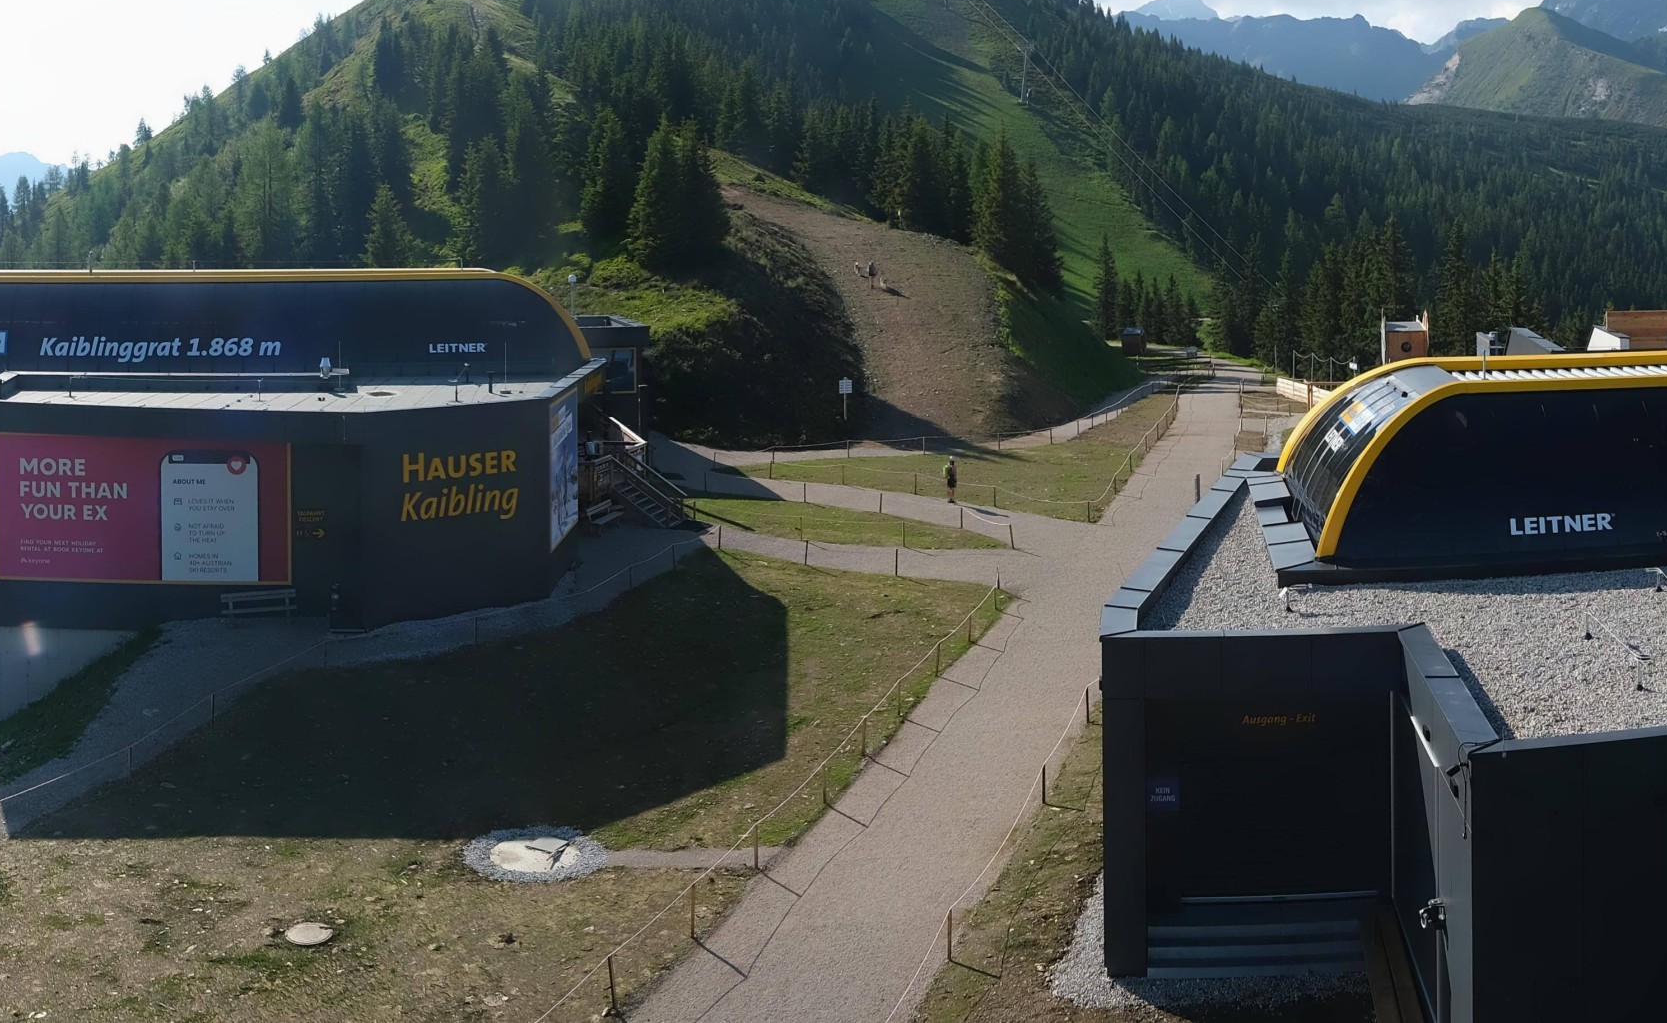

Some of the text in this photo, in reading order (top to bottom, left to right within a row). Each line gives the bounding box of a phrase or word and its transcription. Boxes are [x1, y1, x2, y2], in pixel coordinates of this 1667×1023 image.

[39, 336, 281, 362] Kaiblinggrat 1.868 m
[428, 342, 487, 354] LEITNER
[19, 457, 86, 476] MORE
[402, 449, 517, 484] HAUSER
[19, 480, 128, 499] FUN THAN
[400, 483, 519, 522] Kaibling
[20, 503, 108, 521] YOUR EX
[1242, 714, 1287, 727] Ausgang
[1296, 712, 1316, 723] Exit
[1150, 794, 1176, 802] ZUGANG
[1155, 786, 1171, 794] KEIN
